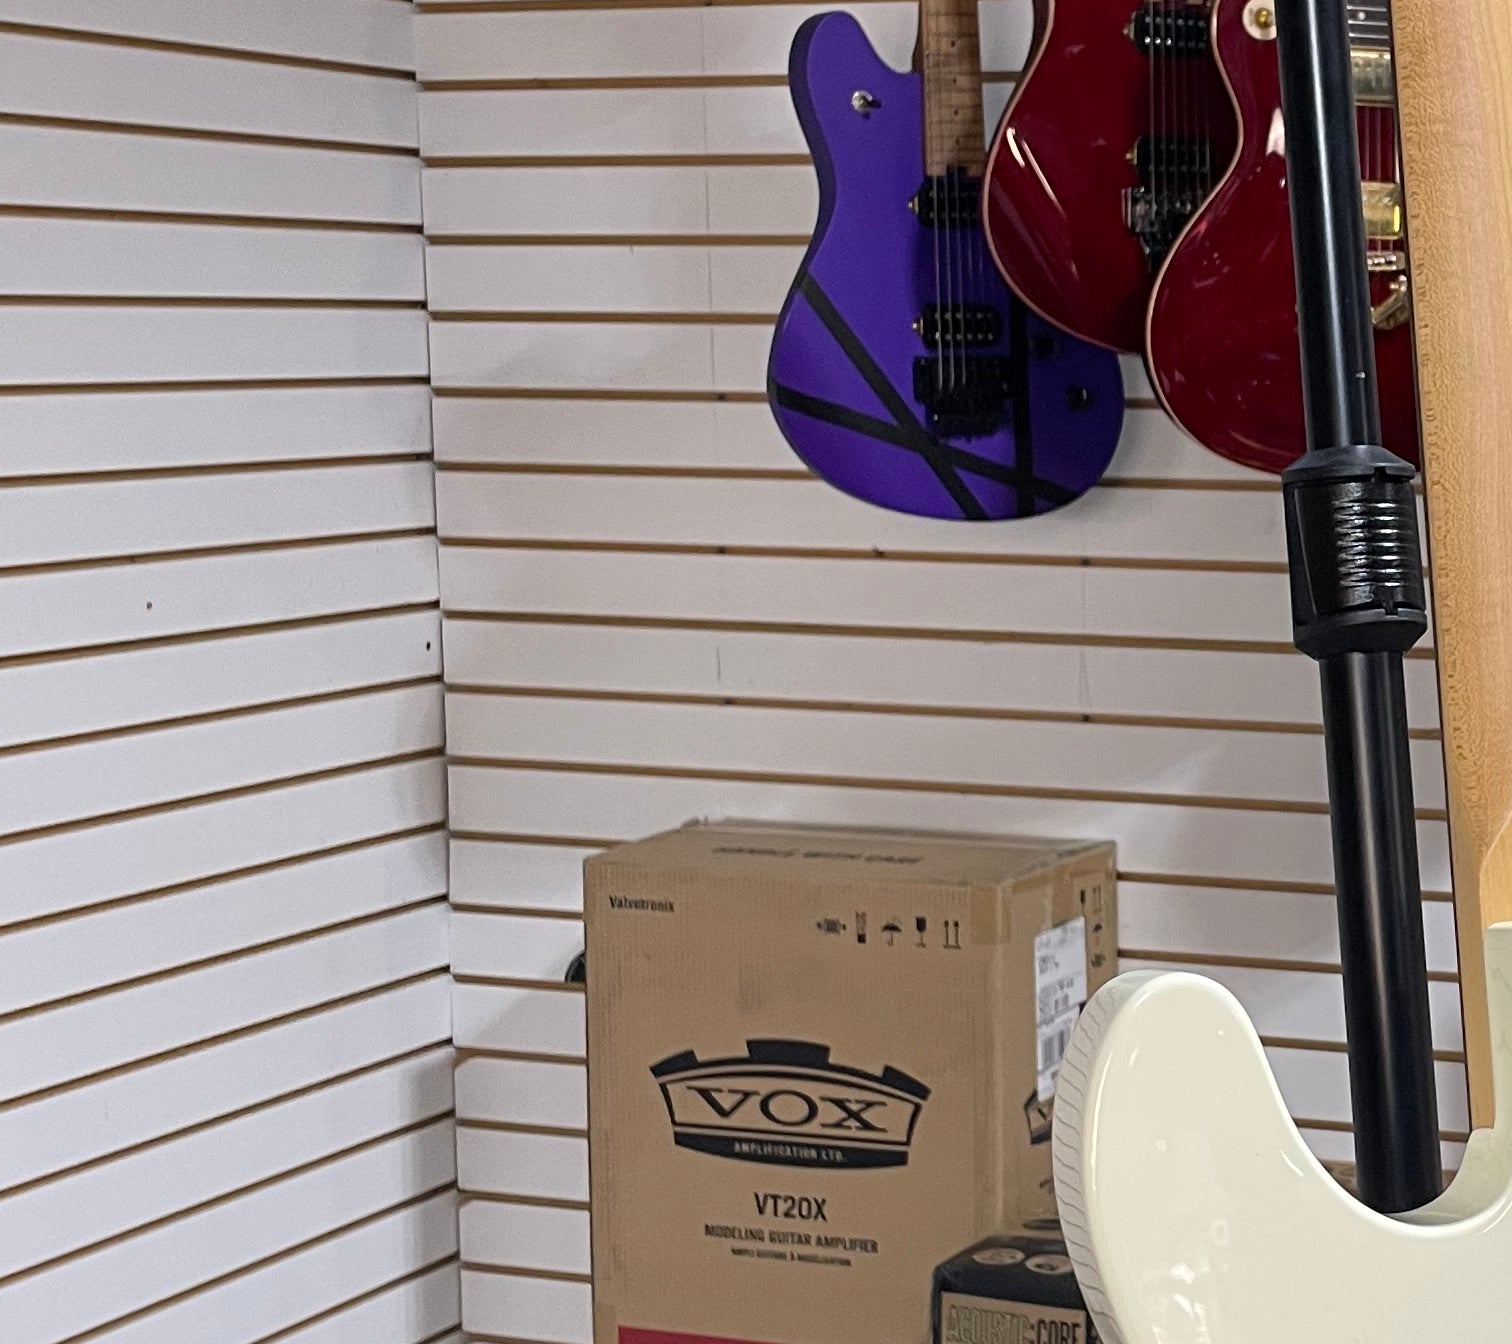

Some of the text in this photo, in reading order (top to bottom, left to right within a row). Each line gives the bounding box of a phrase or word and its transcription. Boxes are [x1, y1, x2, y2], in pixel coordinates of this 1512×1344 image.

[609, 894, 676, 914] Valvetronix
[686, 1085, 889, 1134] VOX
[733, 1140, 819, 1161] AMPLIFICATION
[753, 1191, 829, 1223] VT20X
[815, 1235, 879, 1255] AMPLIFIER
